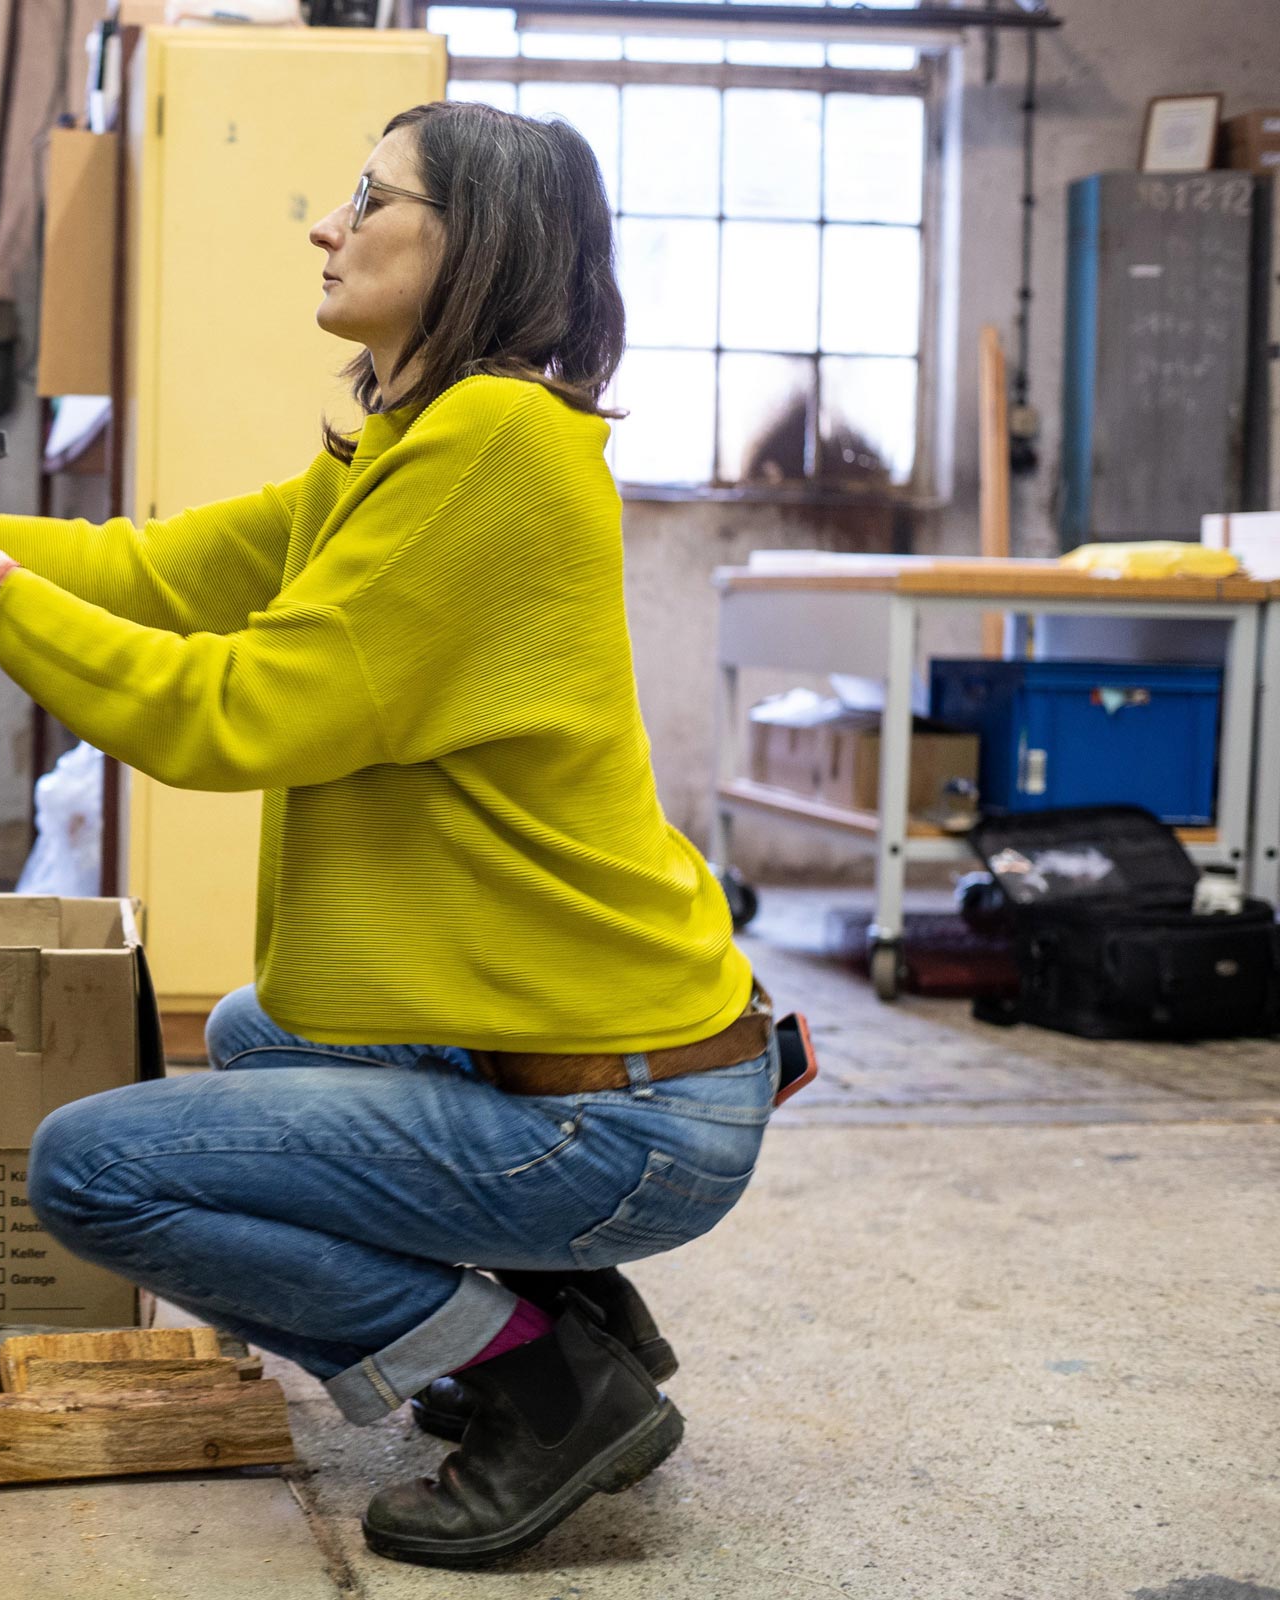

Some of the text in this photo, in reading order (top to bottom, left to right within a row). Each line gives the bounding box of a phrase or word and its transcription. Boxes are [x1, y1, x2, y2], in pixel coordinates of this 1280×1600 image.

[10, 1171, 28, 1182] Kü
[10, 1196, 29, 1207] Ba
[10, 1248, 47, 1259] Keller
[10, 1274, 57, 1287] Garage
